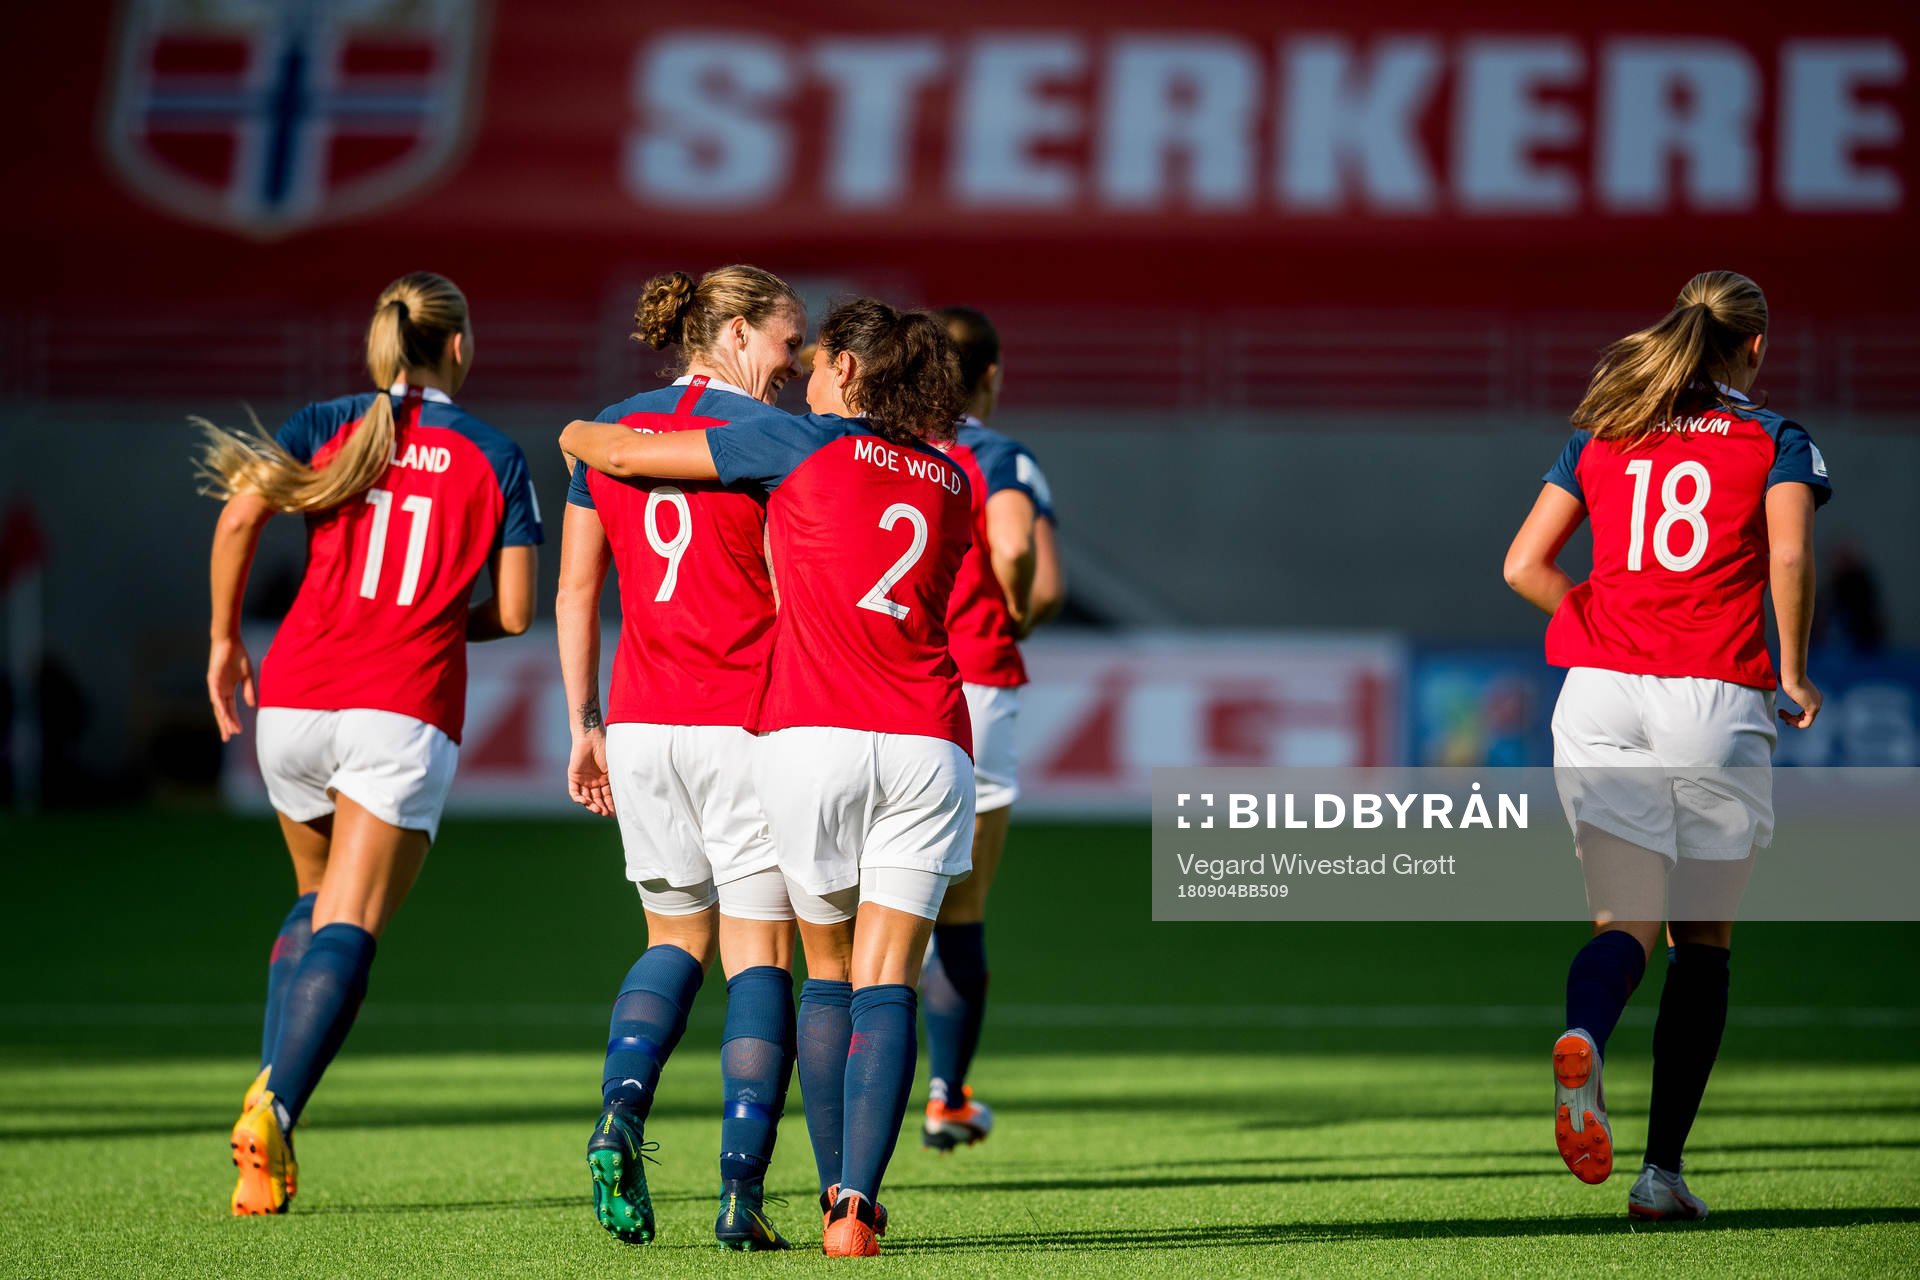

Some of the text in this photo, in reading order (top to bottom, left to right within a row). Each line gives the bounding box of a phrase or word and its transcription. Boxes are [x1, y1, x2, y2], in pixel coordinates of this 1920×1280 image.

[628, 33, 1902, 211] STERKERE
[854, 439, 961, 495] MOE WOLD
[1624, 459, 1711, 572] 18
[359, 489, 432, 606] 11
[644, 487, 692, 602] 9
[856, 503, 928, 620] 2
